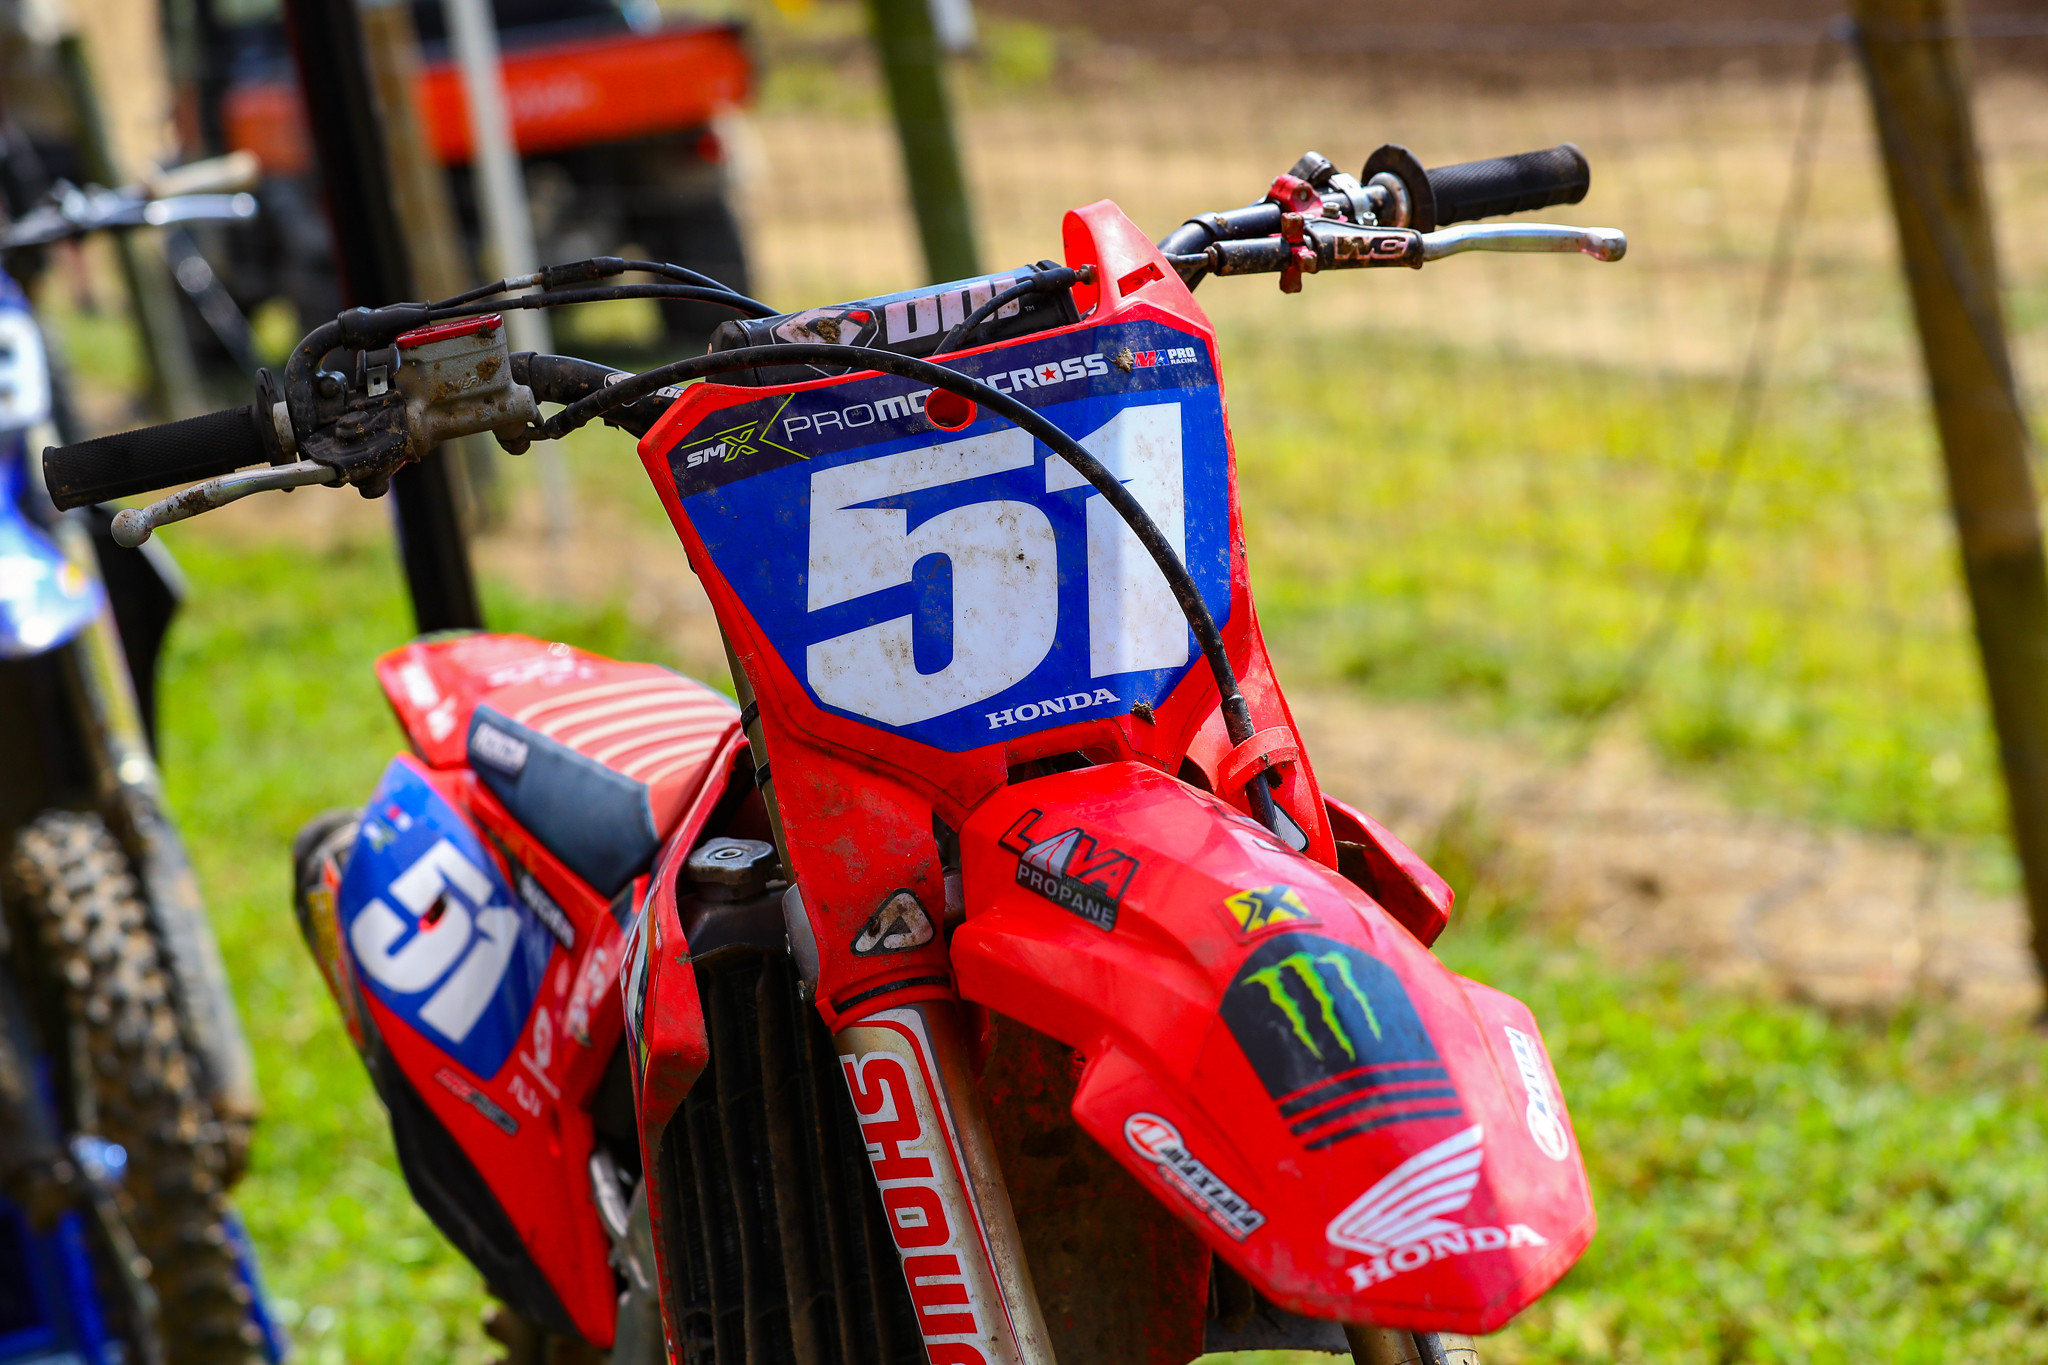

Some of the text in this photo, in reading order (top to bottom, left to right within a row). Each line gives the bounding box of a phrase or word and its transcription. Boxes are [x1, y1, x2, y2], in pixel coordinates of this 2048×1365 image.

[1132, 349, 1170, 369] MA
[1167, 347, 1196, 359] PRO
[1170, 357, 1198, 365] RACING
[686, 427, 759, 469] SMX
[806, 402, 1189, 727] 51
[985, 688, 1121, 730] HONDA
[998, 808, 1141, 901] LAVA
[1017, 863, 1115, 925] PROPANE
[350, 838, 522, 1046] 51
[1345, 1223, 1549, 1293] HONDA
